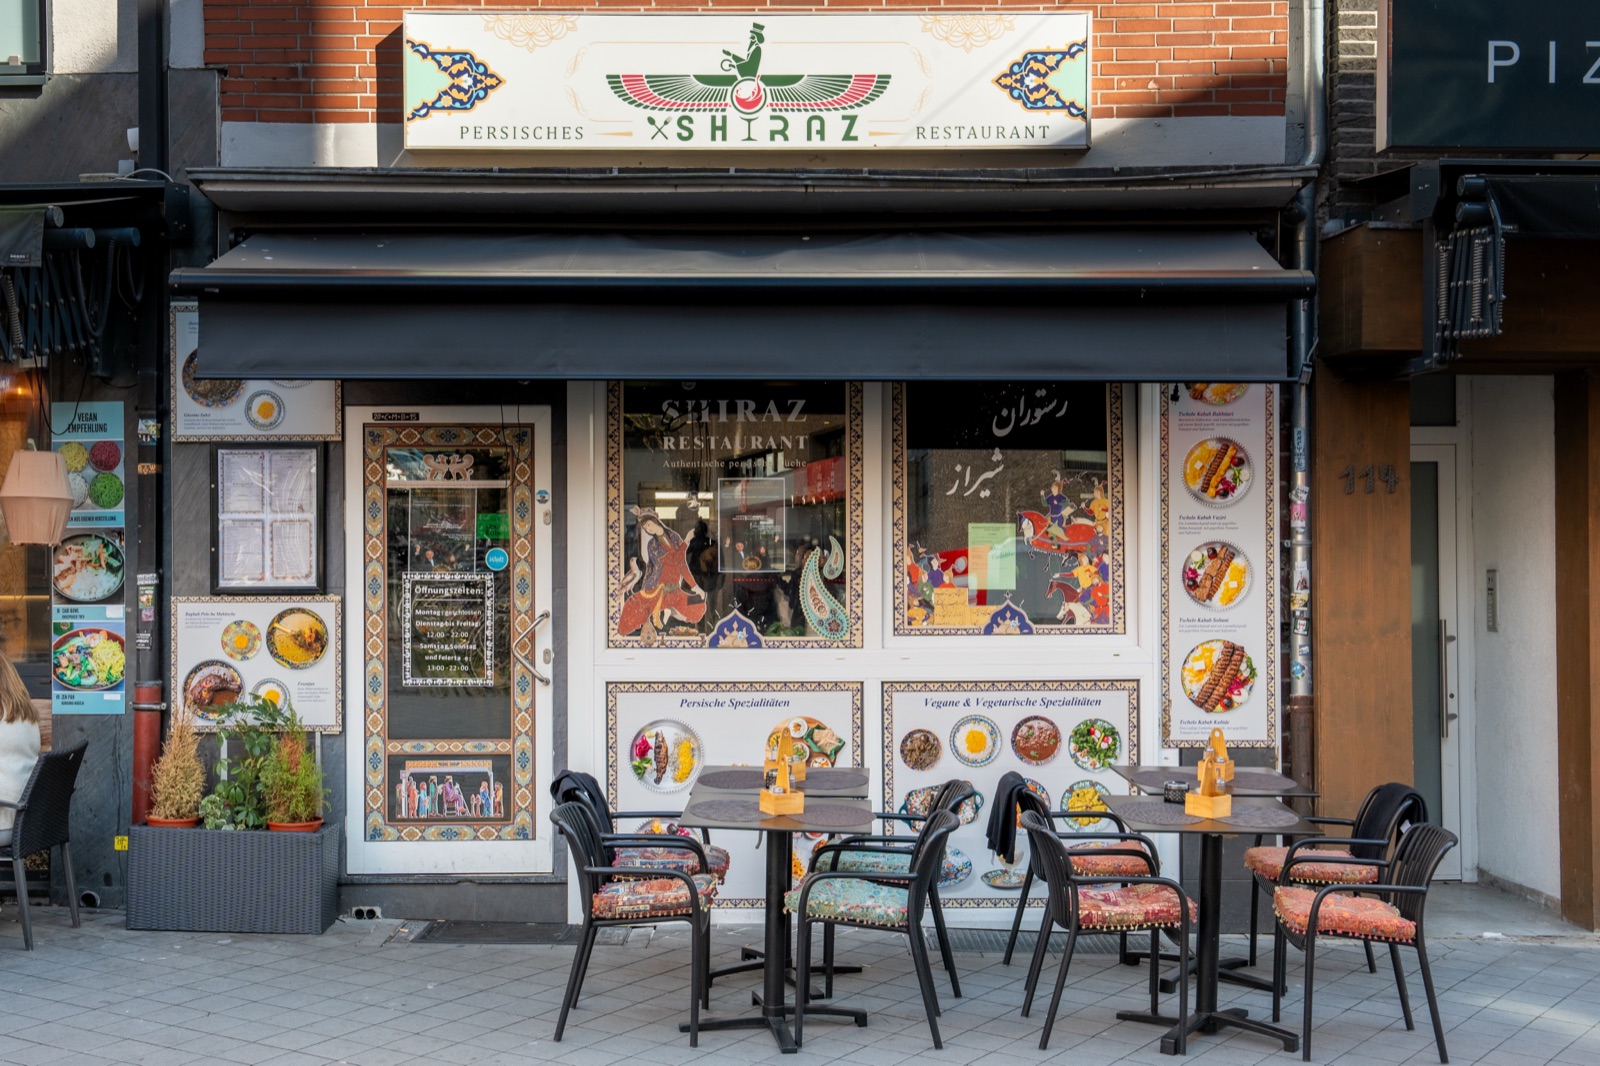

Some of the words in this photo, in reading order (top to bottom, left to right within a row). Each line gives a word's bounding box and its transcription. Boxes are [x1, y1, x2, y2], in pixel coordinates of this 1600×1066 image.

[460, 126, 584, 140] PERSISCHES
[676, 114, 859, 142] SHIRAZ
[916, 125, 1050, 140] RESTAURANT
[77, 412, 98, 422] VEGAN
[661, 399, 807, 423] SHIRAZ
[992, 388, 1068, 437] رستوران
[67, 423, 108, 433] EMPFEHLUNG
[663, 435, 809, 450] RESTAURANT
[663, 459, 725, 468] Authentische
[946, 447, 1004, 498] شیراز
[1338, 462, 1399, 495] 114
[414, 585, 484, 596] Öffnungszeiten:
[680, 698, 726, 708] Persische
[728, 698, 790, 710] Spezialitäten
[924, 698, 960, 709] Vegane
[962, 698, 971, 707] &
[975, 697, 1037, 709] Vegetarische
[1039, 697, 1102, 709] Spezialitäten
